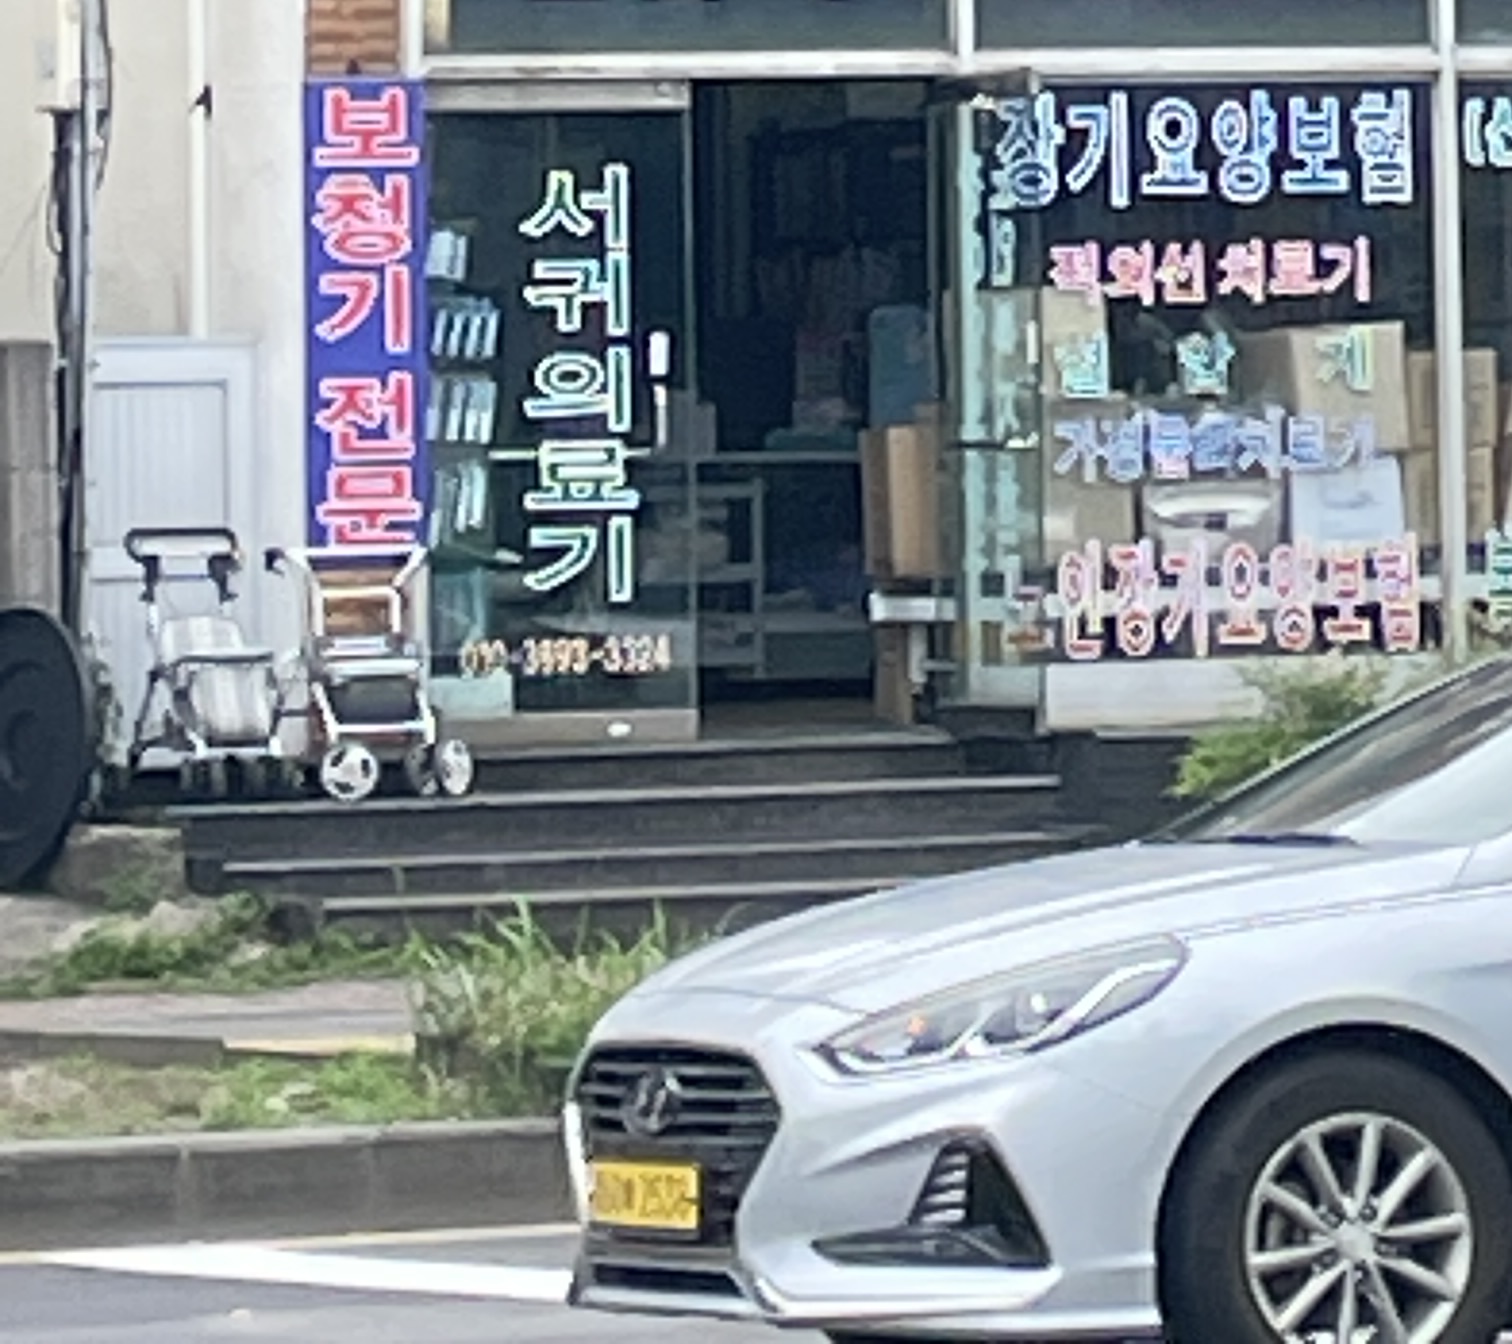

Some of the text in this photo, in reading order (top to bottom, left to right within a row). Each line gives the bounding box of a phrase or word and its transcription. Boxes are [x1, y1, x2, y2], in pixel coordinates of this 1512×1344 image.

[312, 85, 423, 550] 보청기 전문
[994, 88, 1414, 209] 장기요양보험
[518, 161, 641, 604] 서귀의료기
